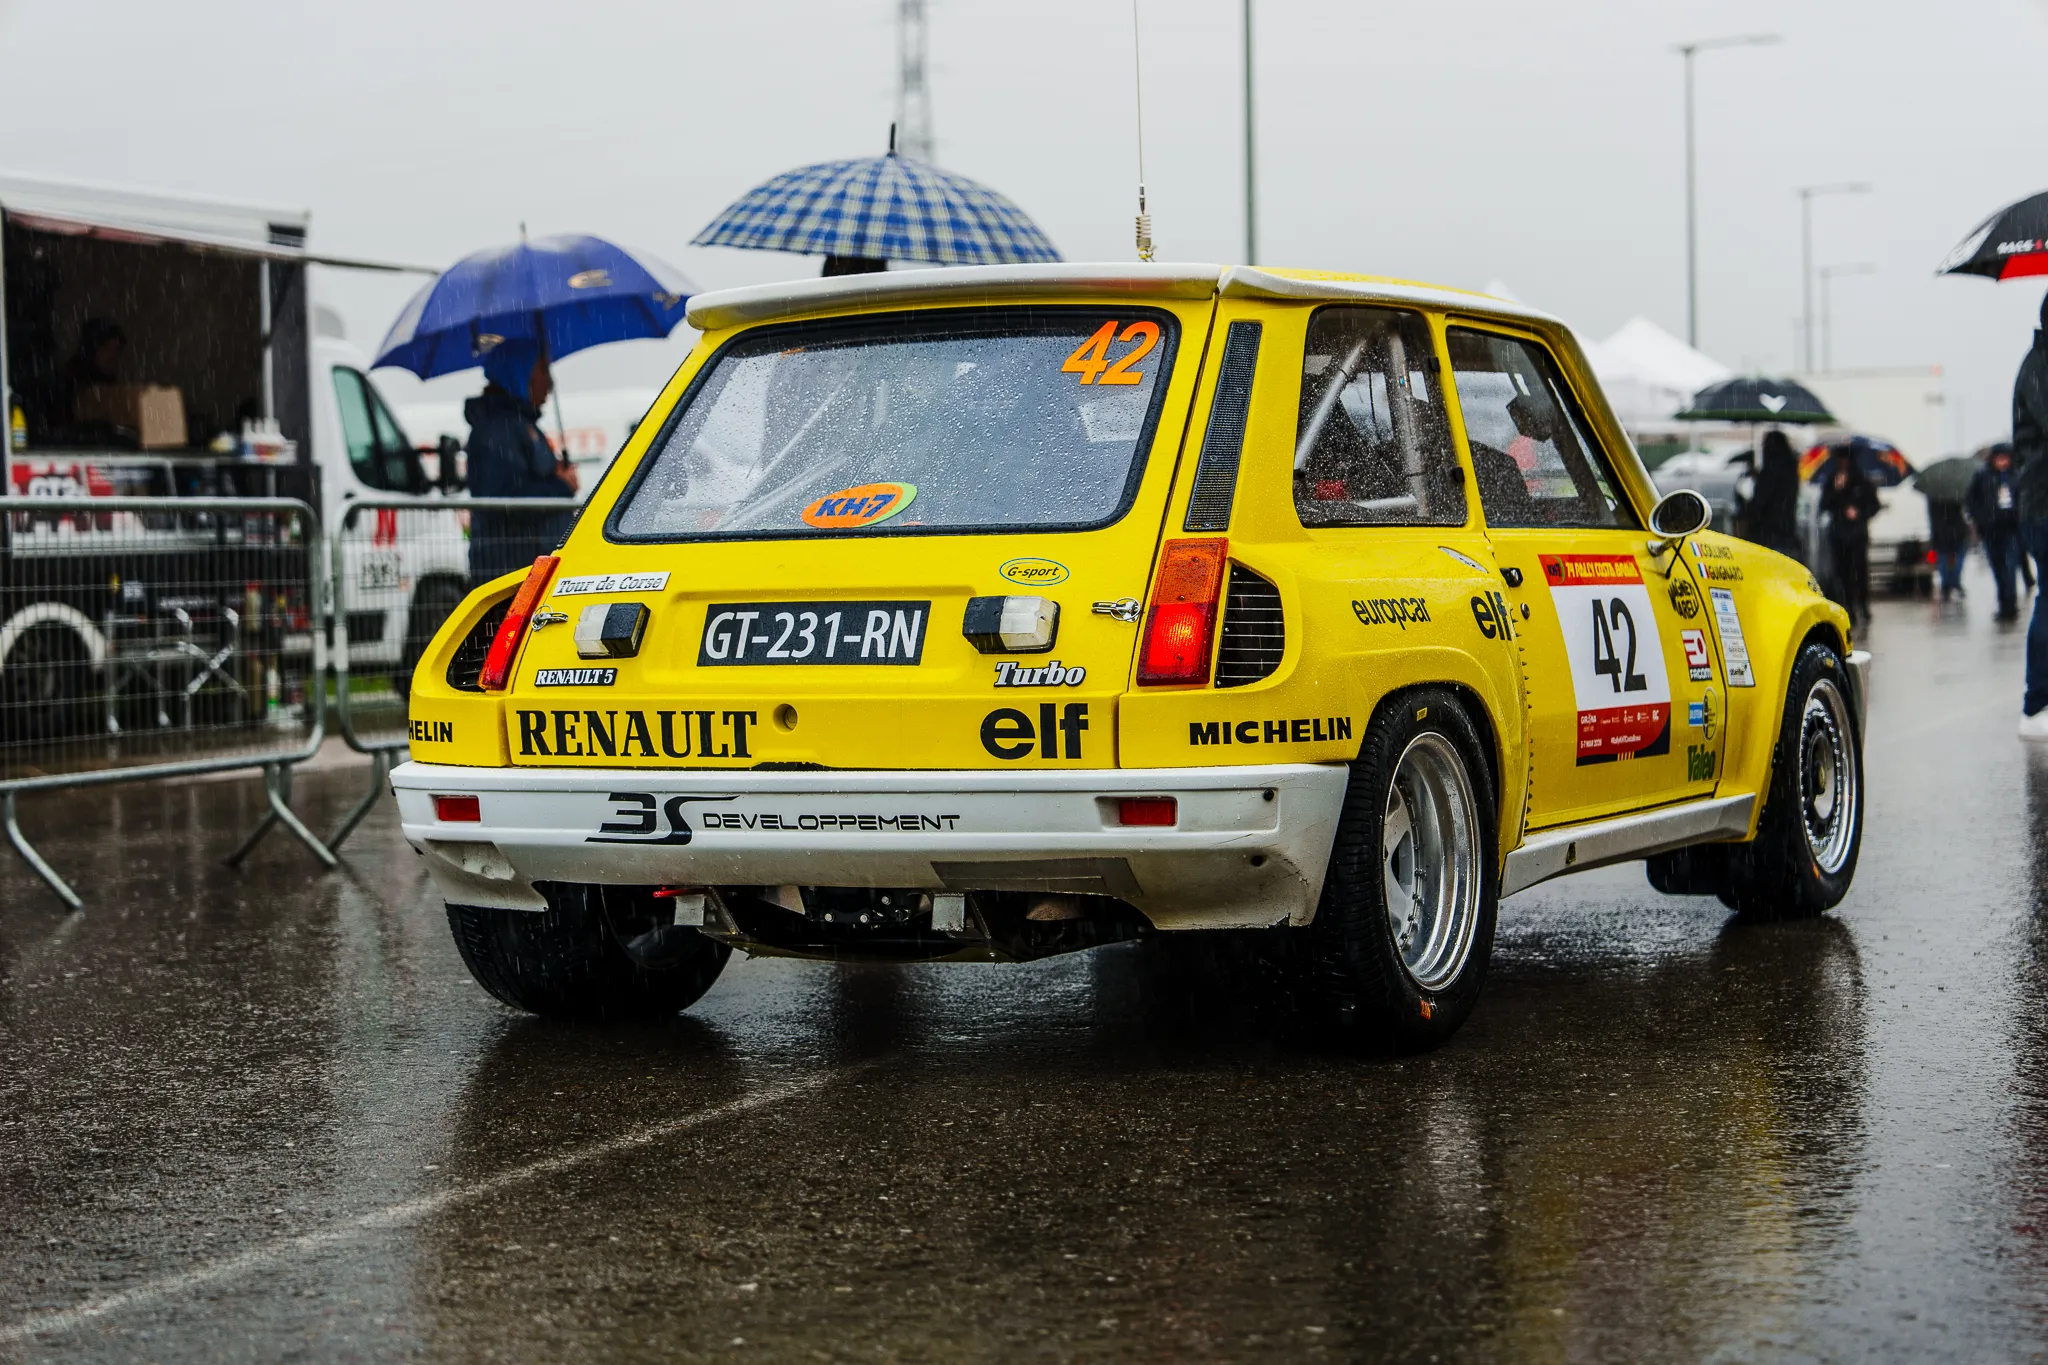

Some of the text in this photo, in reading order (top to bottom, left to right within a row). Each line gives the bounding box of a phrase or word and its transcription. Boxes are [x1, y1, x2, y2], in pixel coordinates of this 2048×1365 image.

[1060, 320, 1160, 386] 42
[557, 576, 663, 594] Tour de Corse
[1007, 566, 1060, 579] G-sport
[1575, 561, 1595, 578] RALLY
[1595, 561, 1614, 578] COSTA
[1351, 597, 1432, 631] europcar
[705, 609, 922, 660] GT-231-RN
[1592, 597, 1648, 693] 42
[535, 669, 614, 685] RENAULT 5
[994, 661, 1086, 687] Turbo
[516, 710, 757, 759] RENAULT
[980, 702, 1089, 760] elf
[1189, 716, 1352, 746] MICHELIN
[1688, 743, 1716, 783] Valeo
[703, 812, 961, 831] DEVELOPPEMENT
